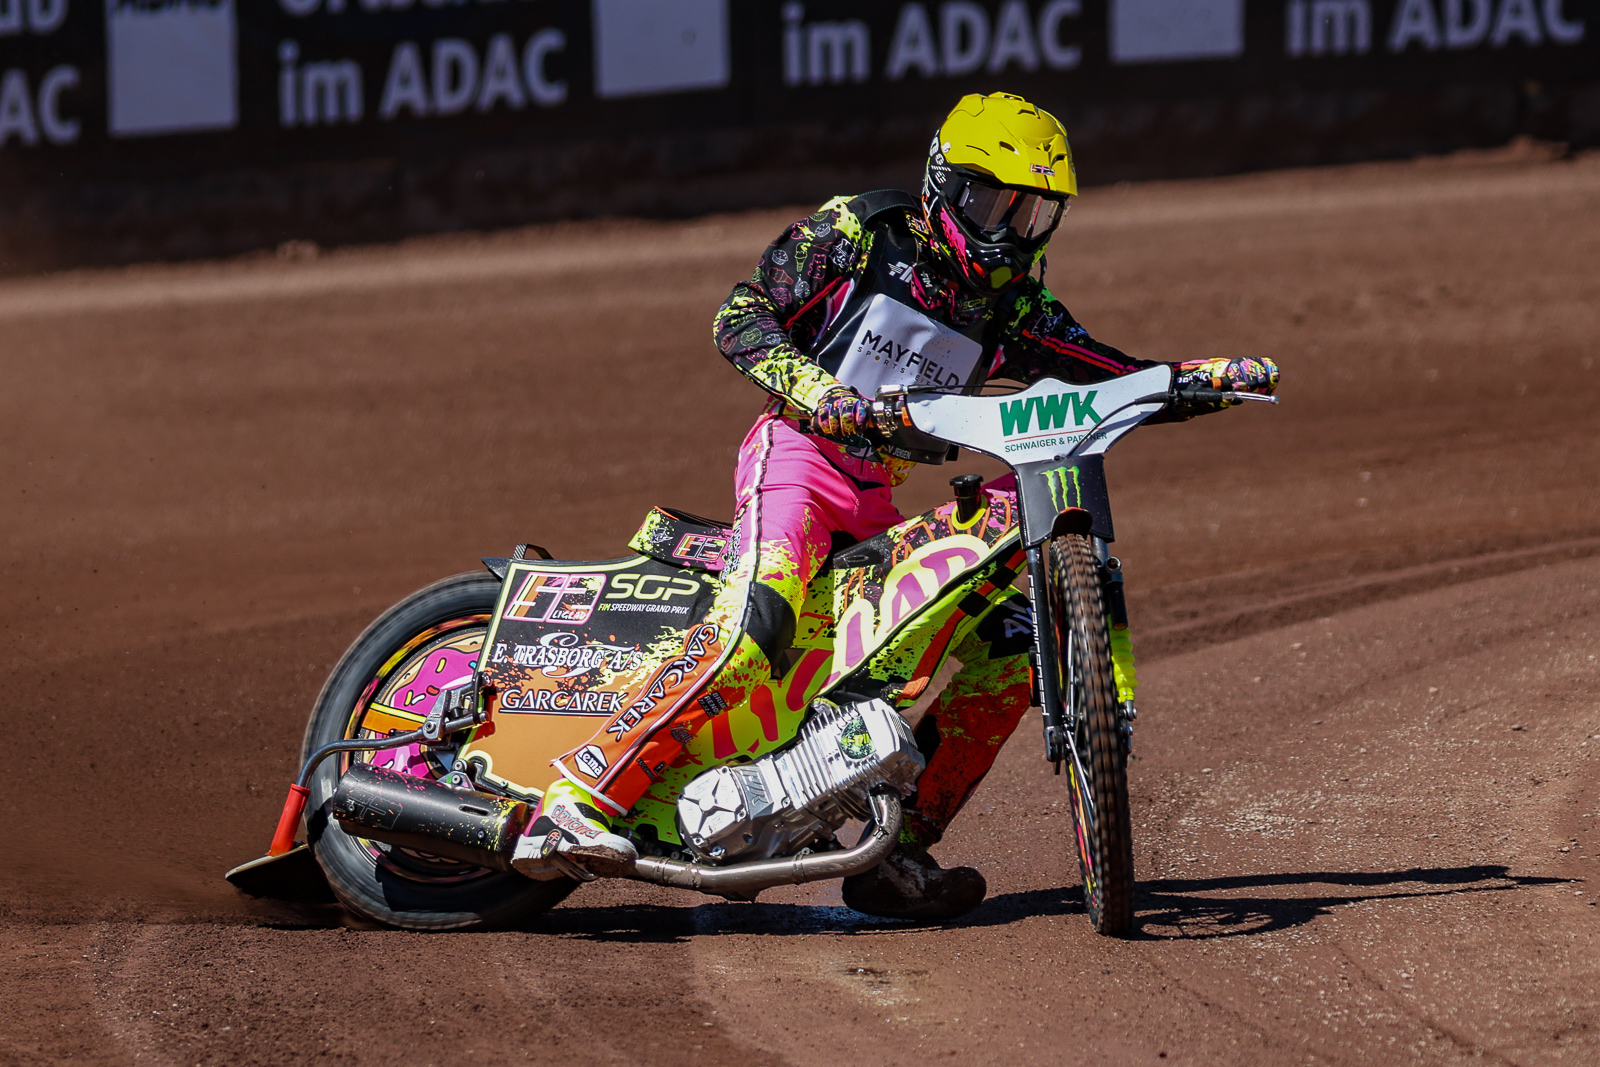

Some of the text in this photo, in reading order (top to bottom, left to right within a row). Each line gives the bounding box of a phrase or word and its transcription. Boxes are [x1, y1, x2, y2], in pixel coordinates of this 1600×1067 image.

[785, 0, 1080, 83] im ADAC
[1289, 0, 1582, 54] im ADAC
[281, 31, 565, 123] im ADAC
[860, 329, 960, 391] MAYFIELD
[998, 390, 1105, 437] WWK
[1004, 437, 1057, 453] SCHWAIGER
[1058, 437, 1066, 446] &
[606, 573, 701, 601] SGP
[598, 603, 690, 615] FIM SPEEDWAY GRAND PRIX
[492, 643, 644, 672] E. TRASBORG A/S
[501, 688, 628, 712] GARCAREK
[607, 623, 721, 742] GARCAREK
[551, 804, 604, 839] daytona
